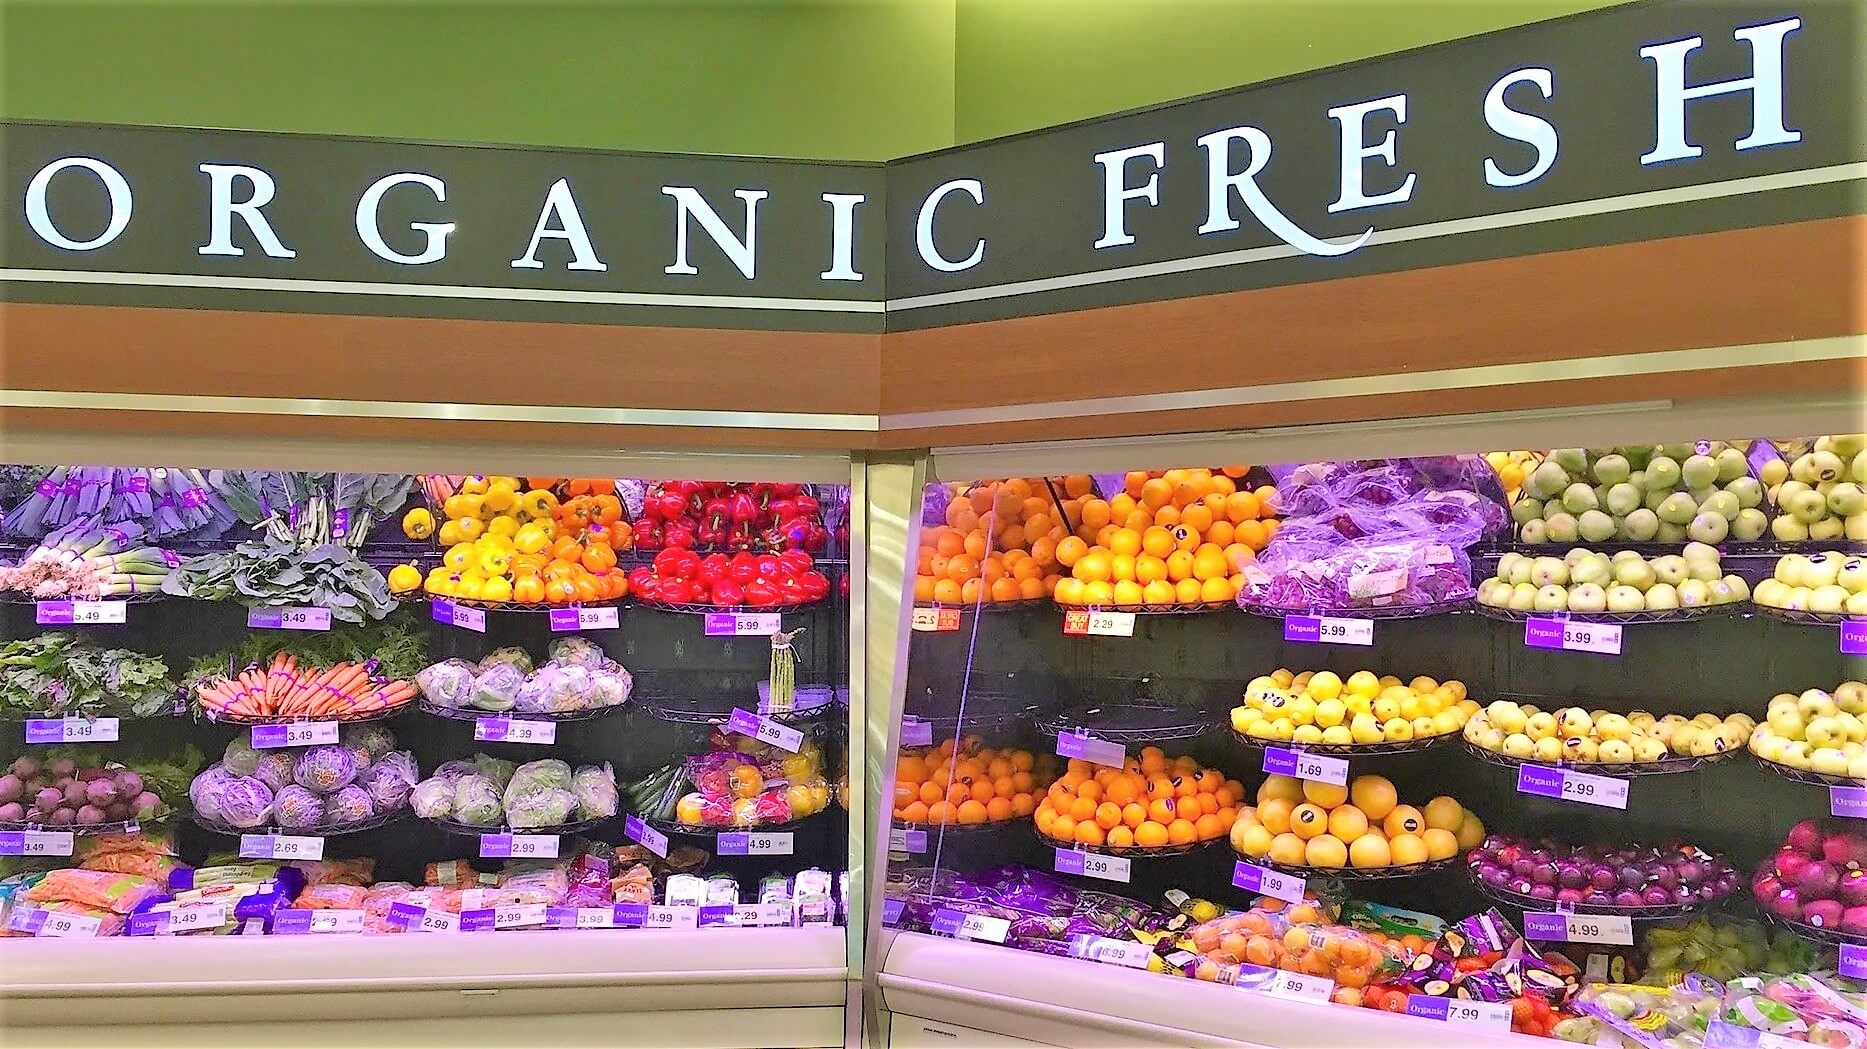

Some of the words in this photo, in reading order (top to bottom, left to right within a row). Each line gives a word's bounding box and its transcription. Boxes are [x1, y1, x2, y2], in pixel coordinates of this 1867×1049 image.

[25, 156, 987, 281] ORGANIC
[1094, 18, 1802, 256] FRESH
[282, 612, 306, 623] 3.49
[580, 614, 599, 623] 5.99
[707, 620, 734, 629] Organic
[737, 621, 759, 630] 5.99
[1093, 619, 1113, 629] 2.29
[1288, 623, 1318, 635] Organic
[1320, 625, 1346, 636] 5.99
[1529, 627, 1562, 640] Organic
[1563, 630, 1591, 644] 3.99
[65, 725, 92, 737] 3.49
[733, 714, 759, 731] Organic
[759, 724, 781, 739] 5.99
[254, 733, 286, 742] Organic
[288, 731, 313, 742] 3.49
[509, 728, 532, 739] 4.39
[1266, 756, 1296, 769] Organic
[1298, 762, 1322, 777] 1.69
[1522, 774, 1561, 788] Organic
[1563, 781, 1595, 796] 2.99
[24, 843, 44, 852] 3.49
[482, 842, 512, 851] Organic
[513, 843, 535, 853] 2.99
[720, 839, 747, 850] Organic
[749, 838, 771, 849] 4.99
[1056, 856, 1082, 869] Organic
[1085, 860, 1107, 872] 2.99
[1236, 868, 1260, 883] Organic
[1262, 876, 1283, 890] 1.99
[171, 913, 197, 925] 3.49
[424, 917, 449, 930] 2.99
[462, 916, 494, 924] Organic
[496, 913, 521, 923] 2.99
[648, 913, 673, 923] 4.99
[936, 916, 961, 928] Organic
[1526, 921, 1564, 934] Organic
[1568, 924, 1599, 937] 4.99
[1276, 979, 1303, 992] .99
[1410, 1003, 1445, 1016] Organic
[1449, 1005, 1479, 1021] 7.99
